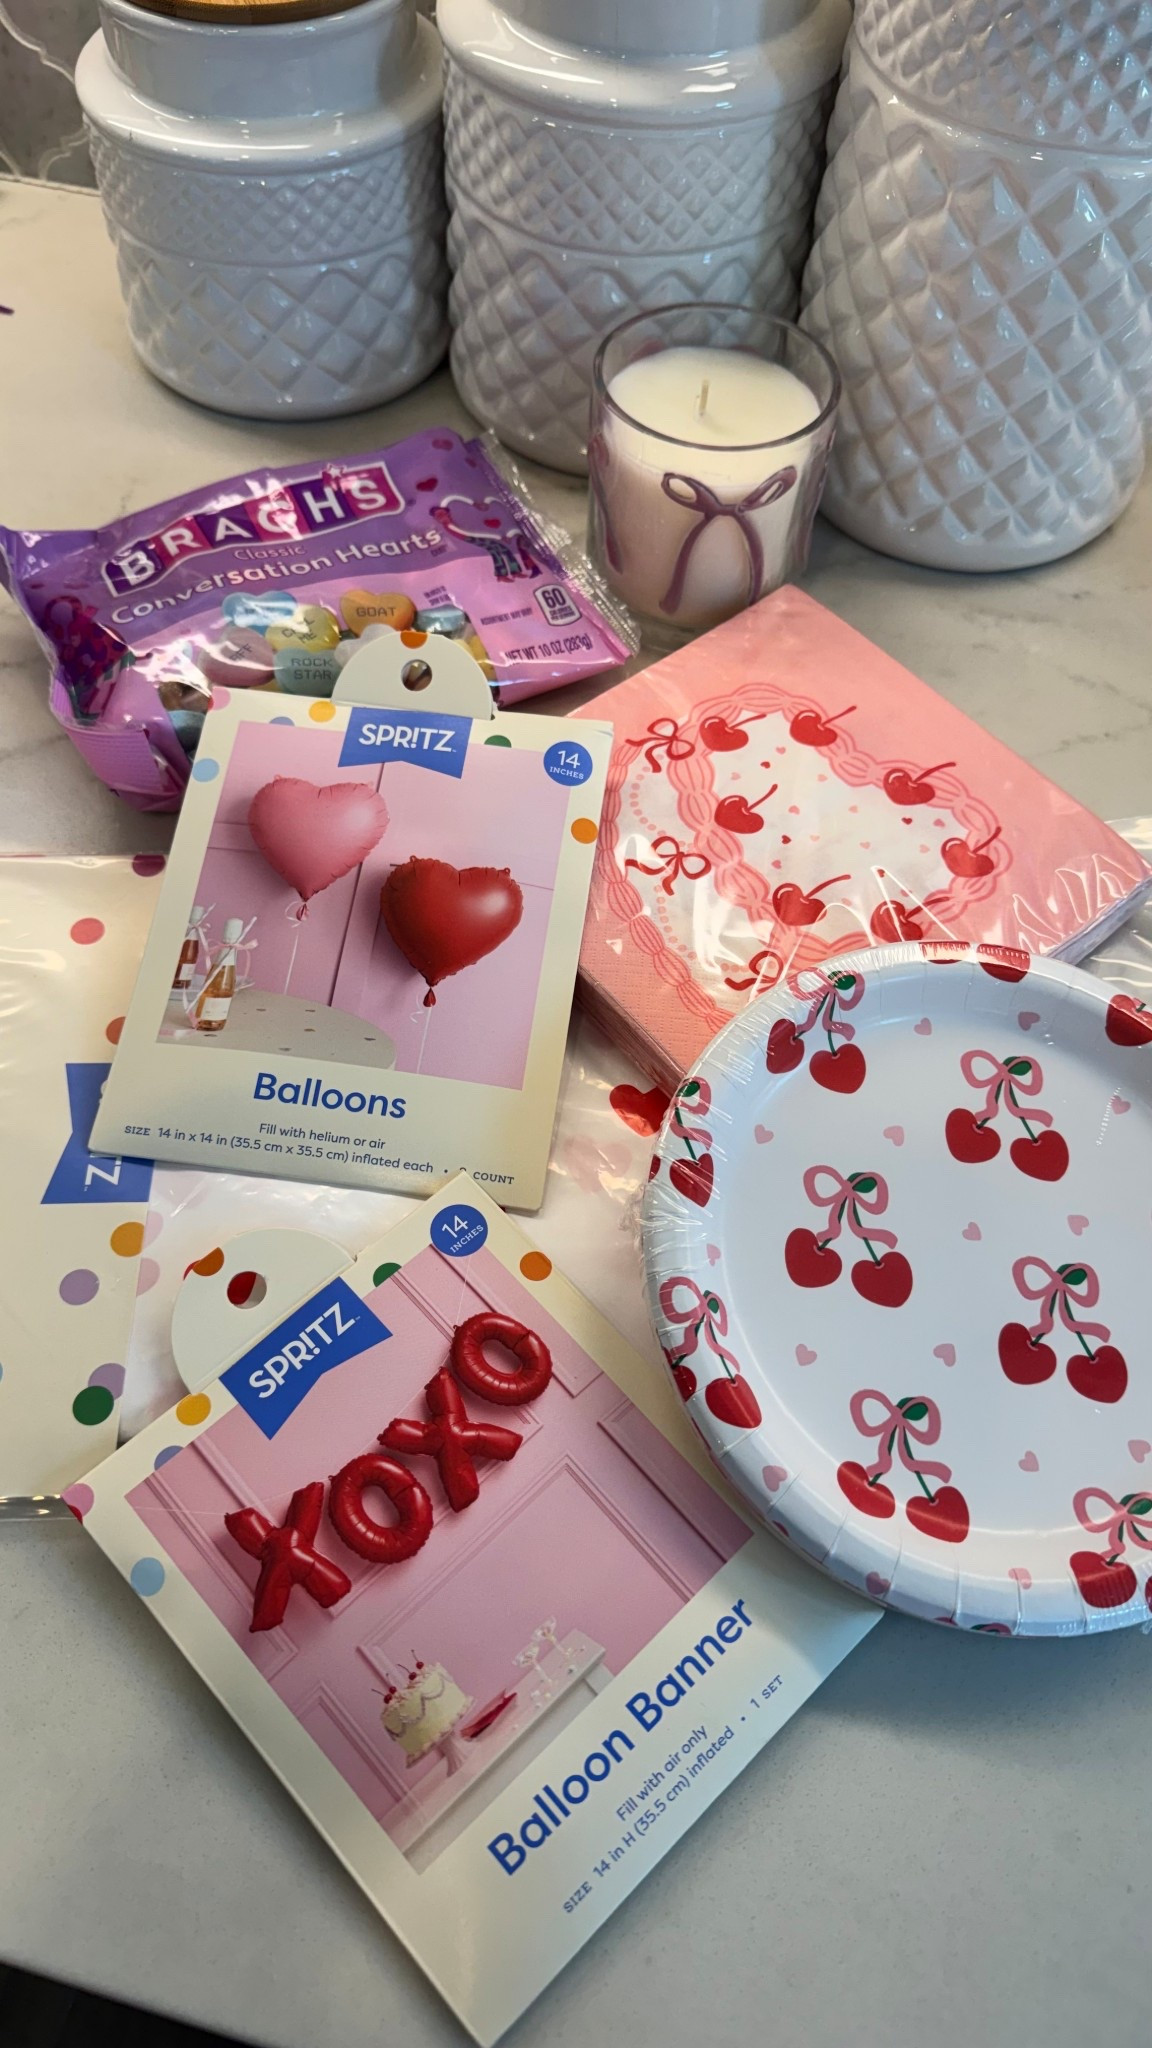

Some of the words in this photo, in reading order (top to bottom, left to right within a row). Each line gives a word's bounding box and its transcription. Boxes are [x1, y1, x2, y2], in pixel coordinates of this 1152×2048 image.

[234, 545, 306, 560] Classic
[111, 556, 333, 624] Conversation
[335, 529, 442, 564] Hearts
[541, 587, 567, 609] 60
[356, 606, 397, 618] GOAT
[291, 657, 333, 668] ROCK
[522, 645, 539, 661] WT
[539, 643, 552, 658] 10
[551, 640, 565, 655] OZ
[293, 669, 332, 681] STAR
[557, 750, 581, 769] 14
[549, 766, 585, 780] INCHES
[253, 1072, 407, 1119] Balloons
[259, 1123, 277, 1135] Fill
[279, 1126, 306, 1139] with
[309, 1129, 350, 1145] helium
[353, 1137, 367, 1147] or
[368, 1138, 386, 1149] air
[124, 1125, 151, 1136] SIZE
[158, 1127, 172, 1139] 14
[174, 1129, 186, 1141] in
[188, 1133, 197, 1143] x
[200, 1132, 213, 1144] 14
[216, 1134, 227, 1146] in
[230, 1135, 261, 1150] (35.5
[264, 1142, 283, 1153] cm
[285, 1145, 294, 1155] x
[296, 1145, 323, 1158] 35.5
[326, 1150, 349, 1164] cm)
[351, 1152, 401, 1169] inflated
[403, 1162, 434, 1173] each
[473, 1171, 515, 1185] COUNT
[441, 1215, 469, 1239] 14
[450, 1224, 484, 1253] INCHES
[224, 1311, 554, 1633] XOXO
[487, 1728, 636, 1876] Balloon
[625, 1598, 753, 1733] Banner
[616, 1796, 638, 1822] Fill
[636, 1771, 666, 1801] with
[664, 1751, 682, 1773] air
[681, 1725, 708, 1754] only
[563, 1881, 593, 1914] SIZE
[592, 1859, 611, 1878] 14
[608, 1846, 625, 1862] in
[621, 1831, 637, 1848] H
[634, 1798, 667, 1837] (35.5
[666, 1774, 691, 1803] cm)
[686, 1725, 735, 1778] inflated
[749, 1698, 761, 1709] 1
[761, 1674, 784, 1700] SET
